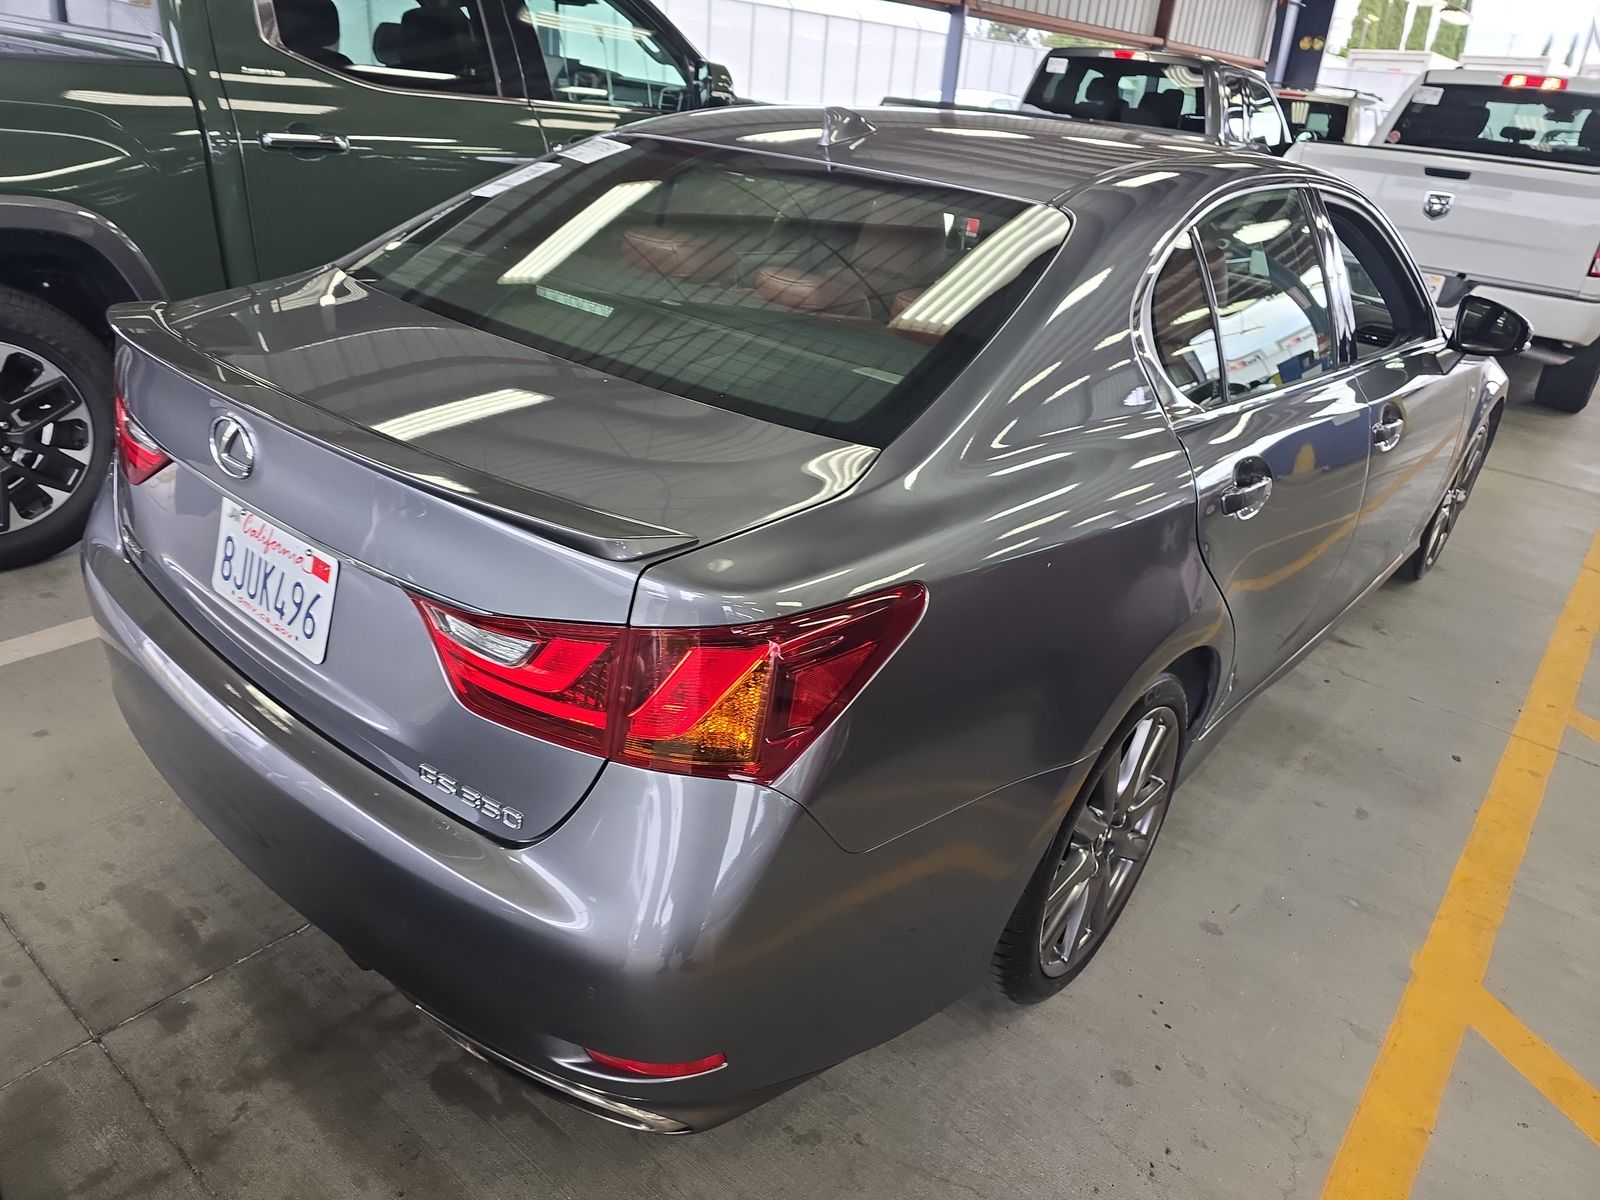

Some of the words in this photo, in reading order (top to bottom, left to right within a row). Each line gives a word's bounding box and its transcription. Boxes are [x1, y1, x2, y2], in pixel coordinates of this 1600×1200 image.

[243, 513, 304, 564] California
[222, 536, 321, 639] 8JUK496
[418, 763, 458, 795] GS
[461, 785, 524, 829] 350
